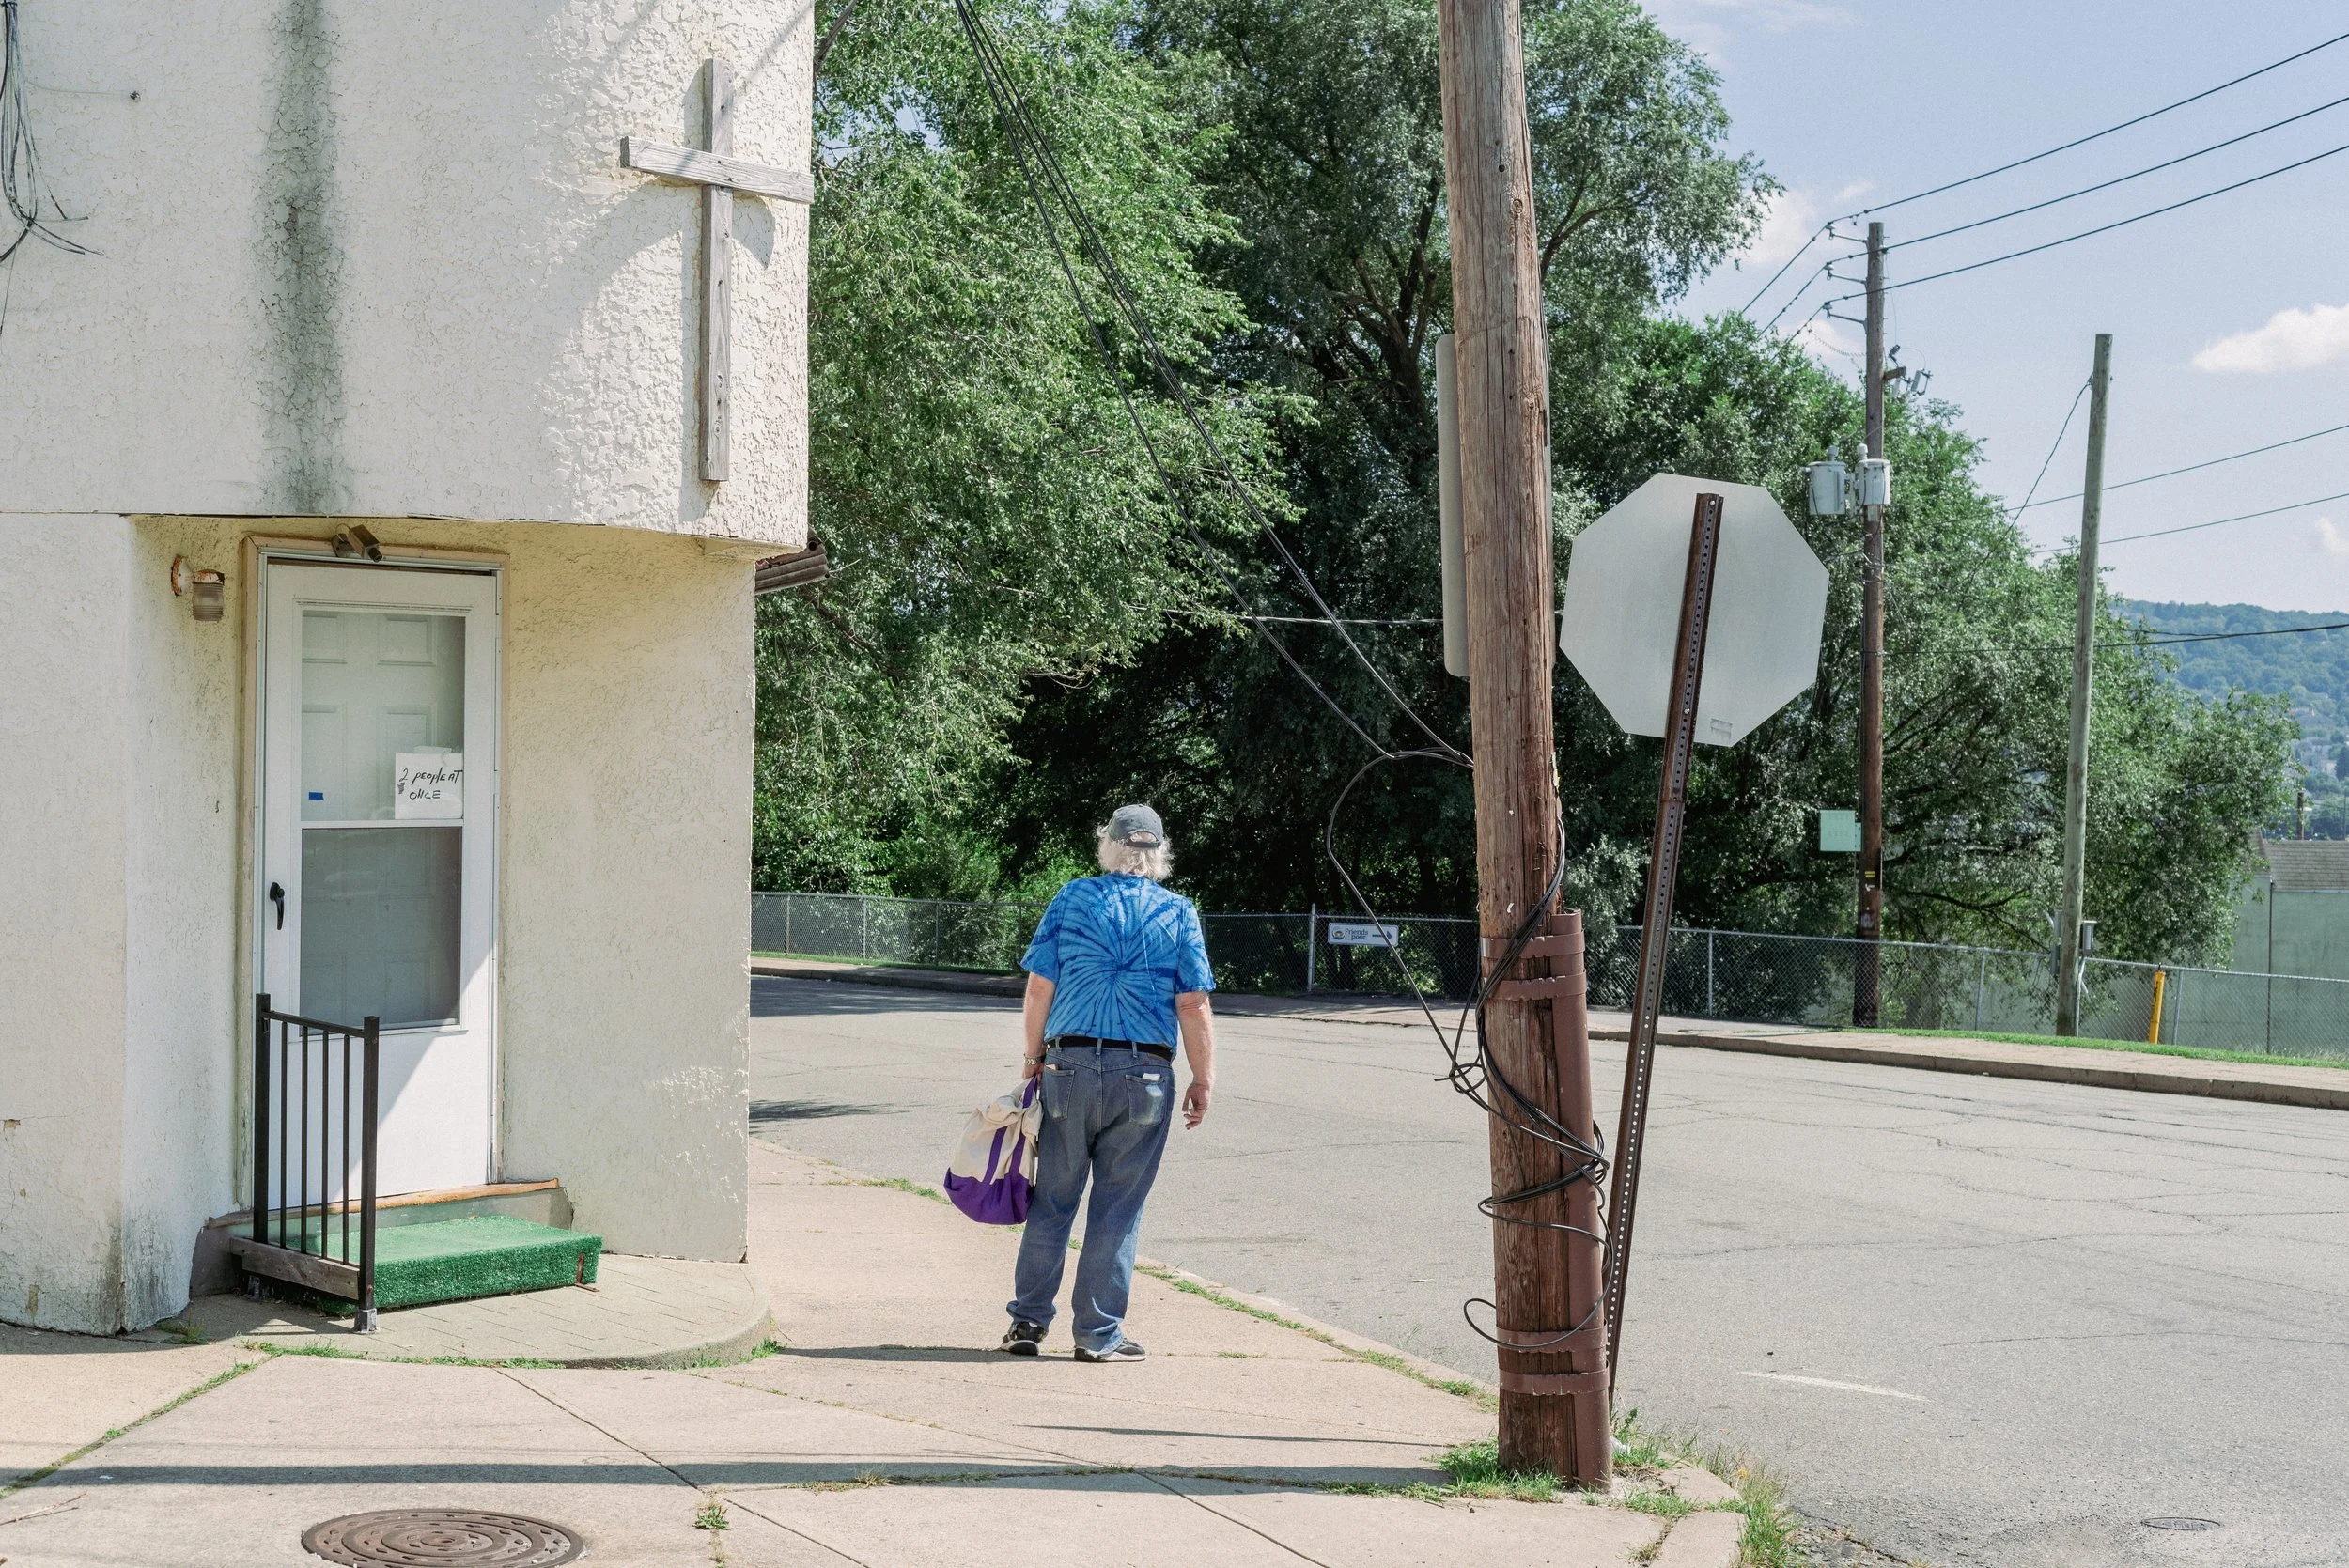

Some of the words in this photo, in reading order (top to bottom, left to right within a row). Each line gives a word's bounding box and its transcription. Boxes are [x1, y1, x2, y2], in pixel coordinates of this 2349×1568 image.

[399, 768, 408, 782] 2
[448, 770, 463, 784] AT
[410, 788, 441, 800] ONCE
